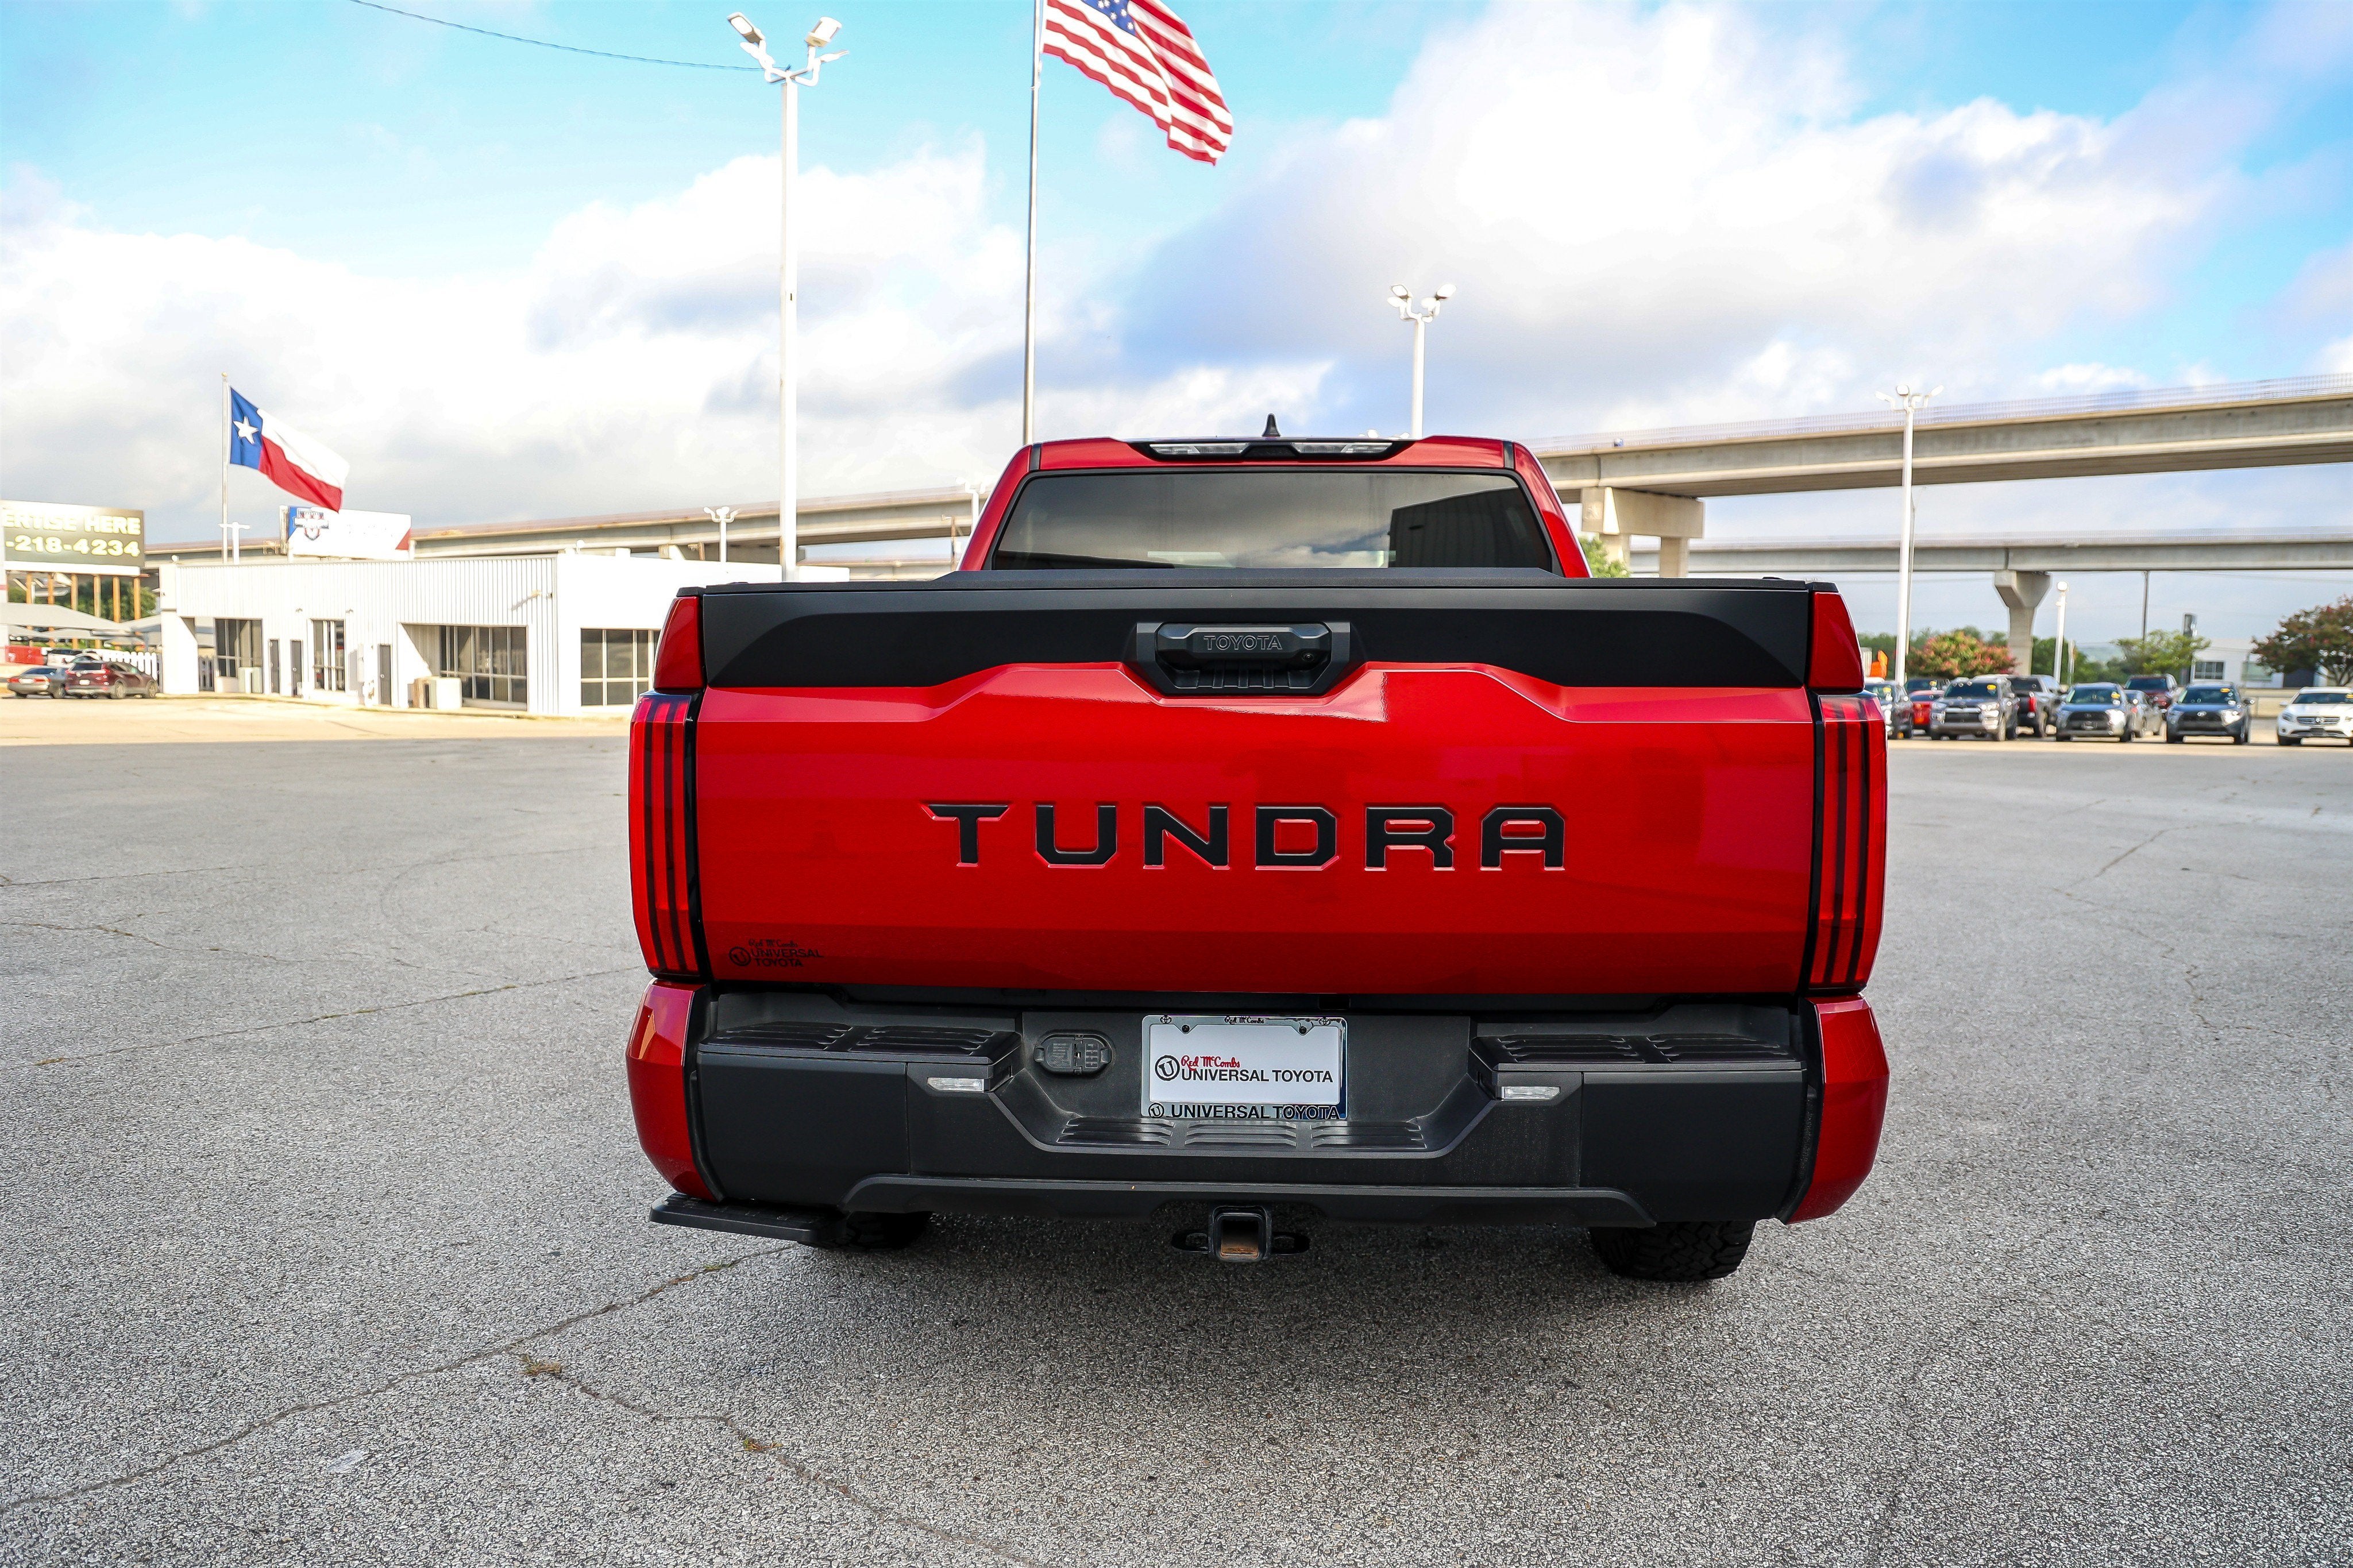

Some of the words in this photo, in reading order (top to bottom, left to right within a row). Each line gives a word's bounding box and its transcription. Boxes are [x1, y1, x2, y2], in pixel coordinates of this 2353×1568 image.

[84, 515, 141, 535] HERE
[1203, 635, 1282, 650] TOYOTA
[921, 804, 1565, 871] TUNDRA
[751, 949, 824, 957] UNIVERSAL
[755, 958, 803, 967] TOYOTA
[1224, 1015, 1237, 1025] Red
[1181, 1055, 1199, 1071] Red
[1200, 1056, 1240, 1068] McCombs
[1182, 1068, 1269, 1082] UNIVERSAL
[1272, 1069, 1333, 1083] TOYOTA
[1171, 1104, 1270, 1119] UNIVERSAL
[1272, 1106, 1340, 1119] TOYOTA
